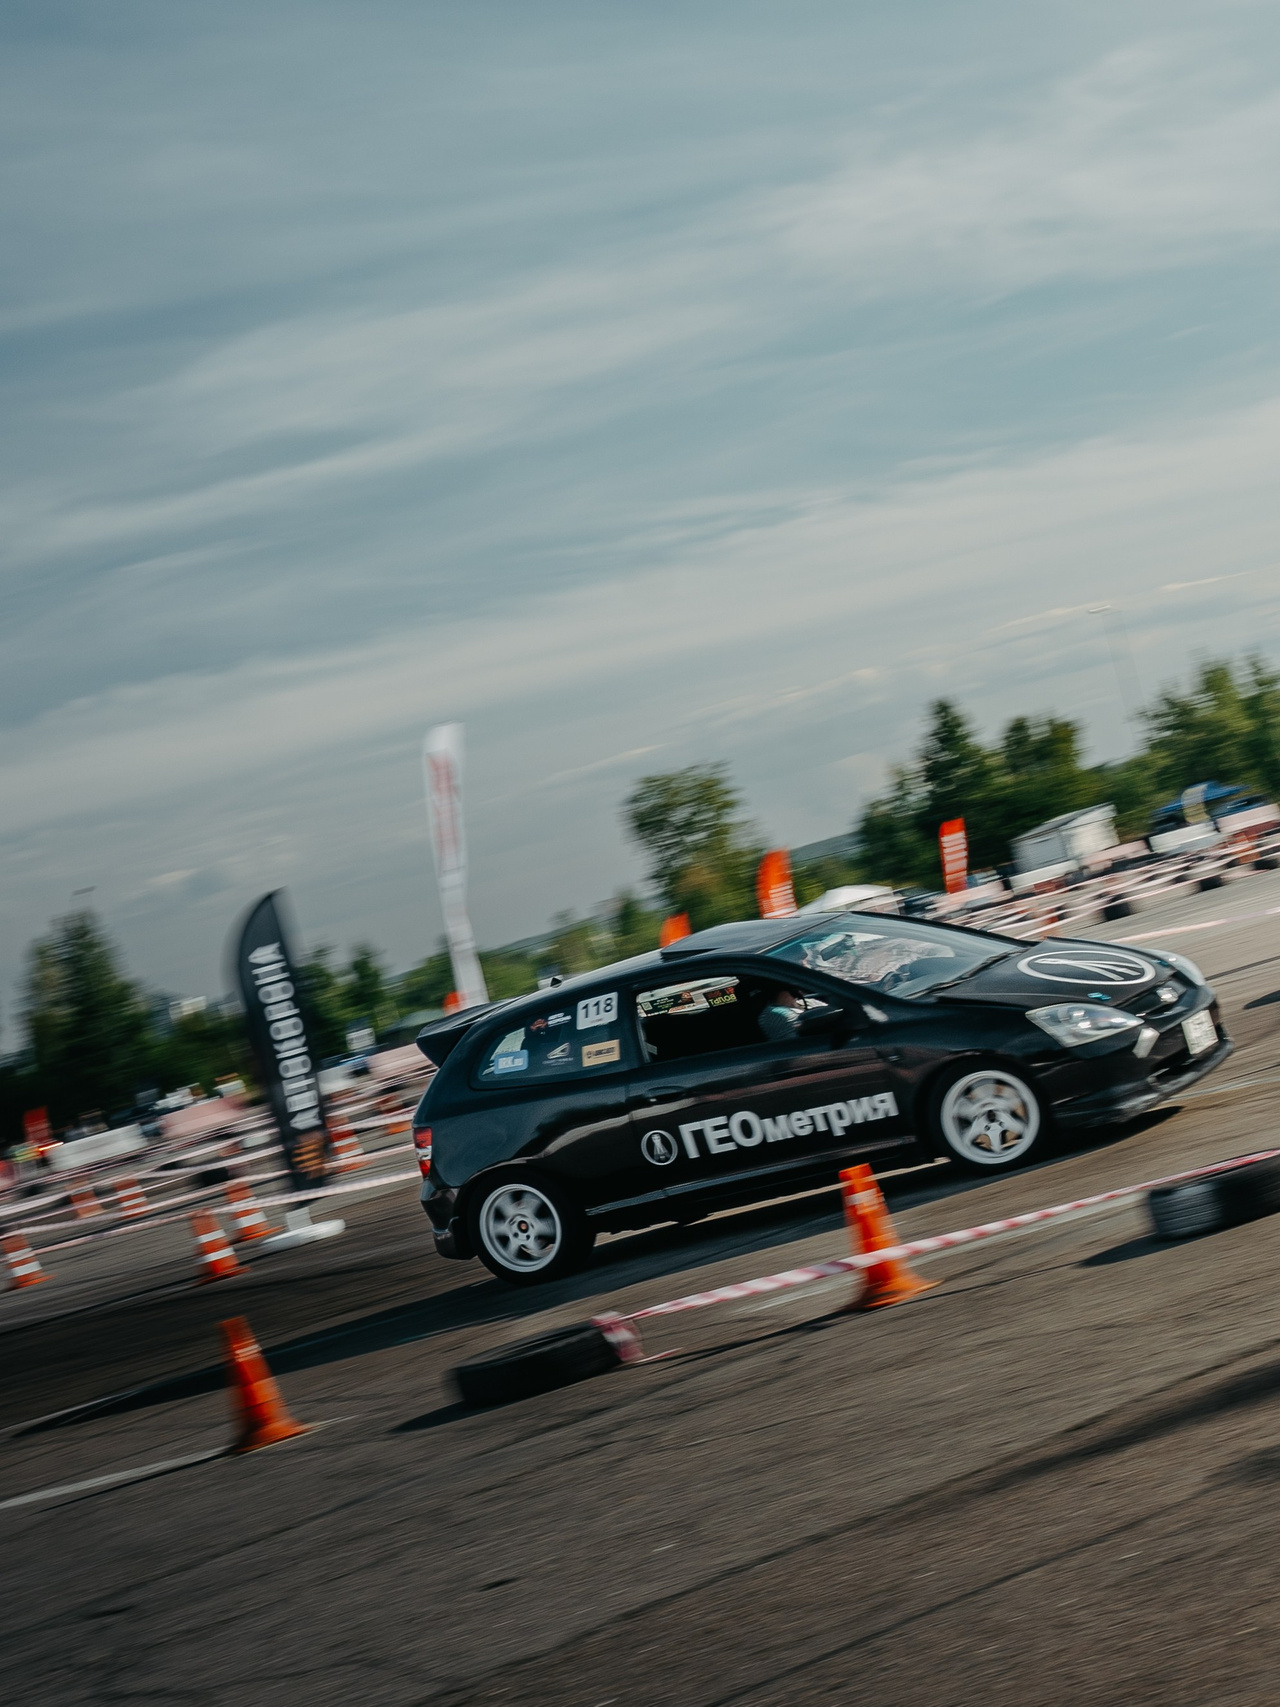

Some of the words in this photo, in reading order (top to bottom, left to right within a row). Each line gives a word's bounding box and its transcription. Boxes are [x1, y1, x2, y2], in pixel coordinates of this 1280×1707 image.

[248, 942, 322, 1130] АВТОКОРОНА
[582, 997, 613, 1019] 118
[678, 1091, 899, 1159] ГЕОметрия
